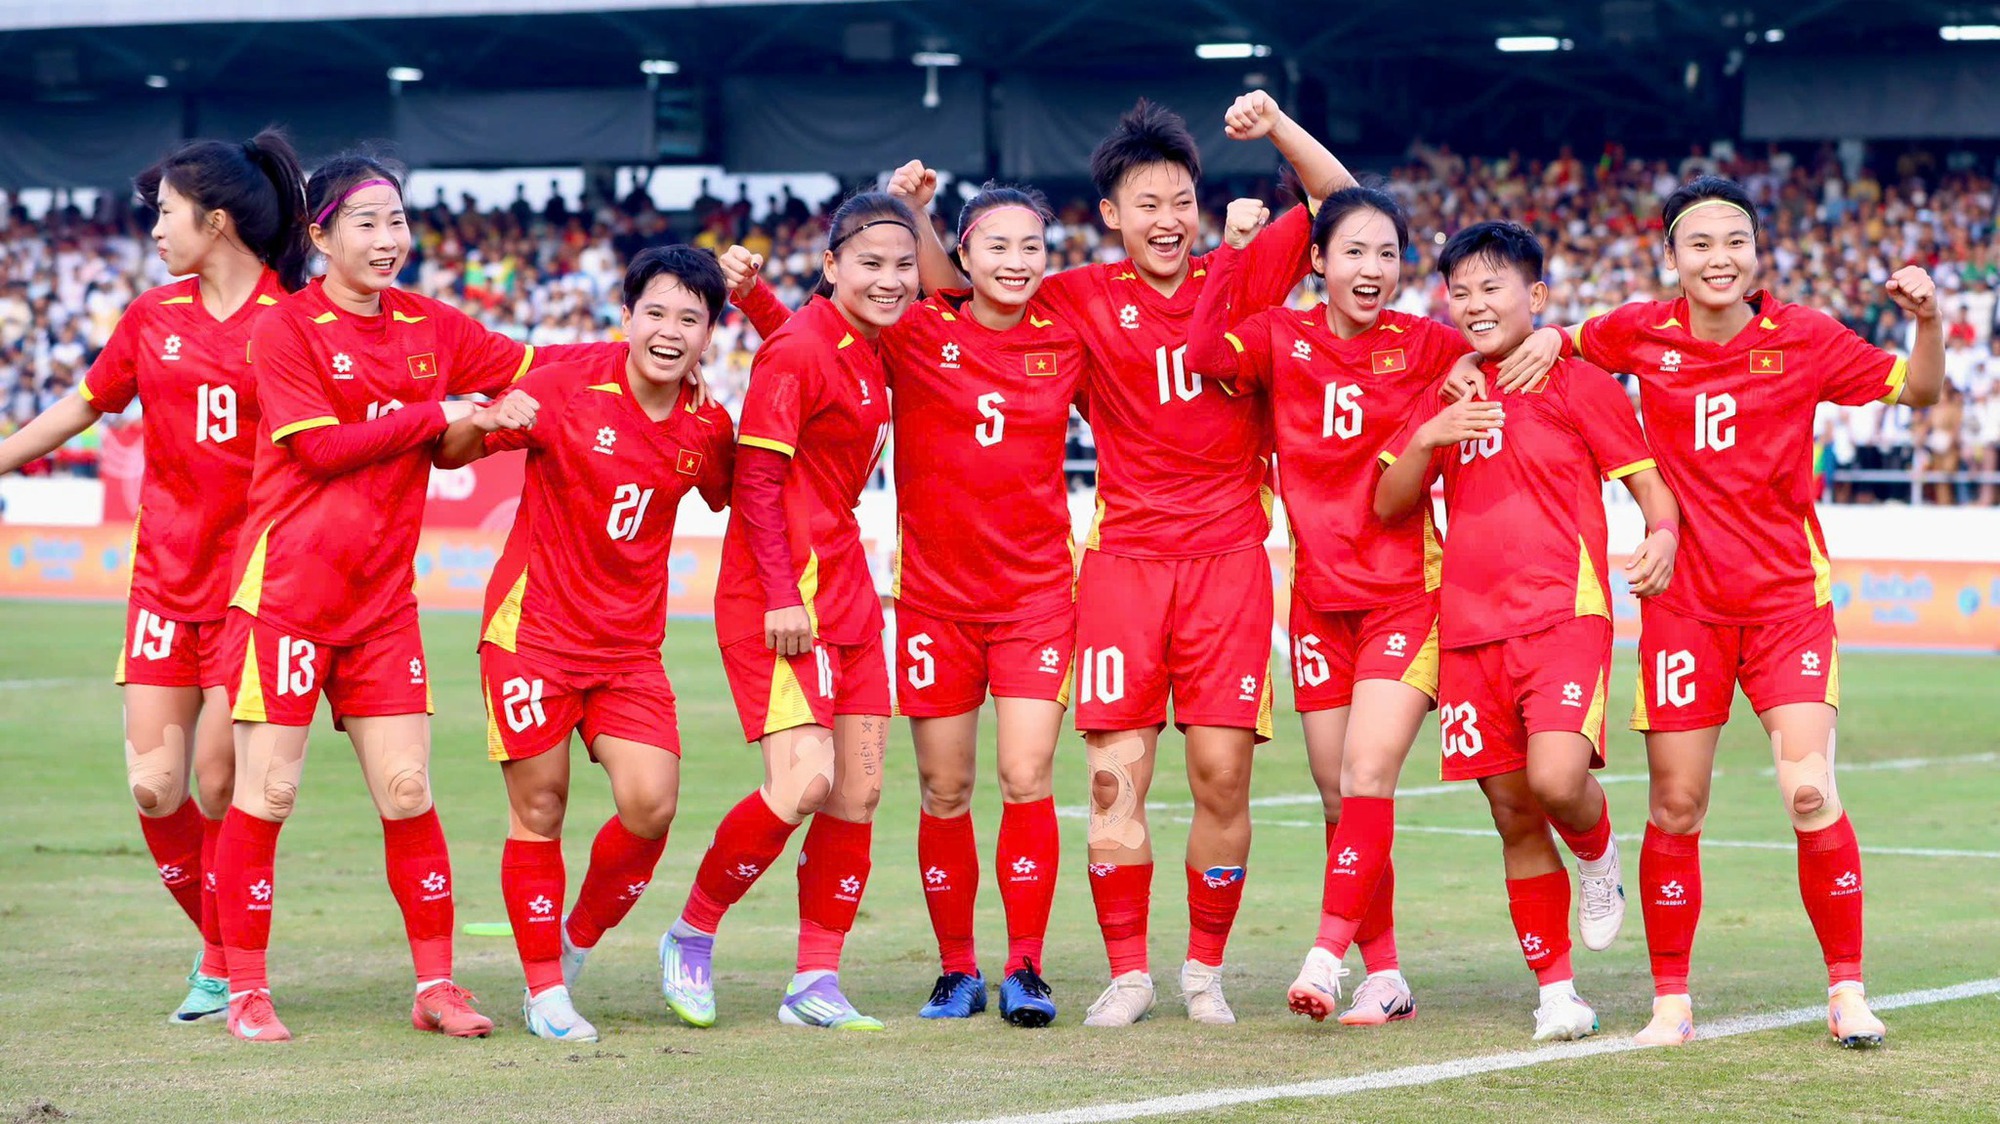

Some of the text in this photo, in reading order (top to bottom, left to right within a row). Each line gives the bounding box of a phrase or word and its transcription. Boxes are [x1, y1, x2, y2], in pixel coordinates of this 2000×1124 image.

[196, 383, 237, 443] 19
[975, 391, 1006, 447] 5
[1322, 381, 1364, 440] 15
[1694, 392, 1737, 452] 12
[606, 483, 655, 541] 21
[131, 608, 176, 661] 19
[907, 632, 935, 690] 5
[1294, 633, 1331, 688] 15
[277, 635, 316, 697] 13
[815, 645, 834, 700] 11
[1080, 645, 1125, 705] 10
[1656, 649, 1696, 708] 12
[502, 676, 548, 734] 21
[1440, 701, 1484, 758] 23
